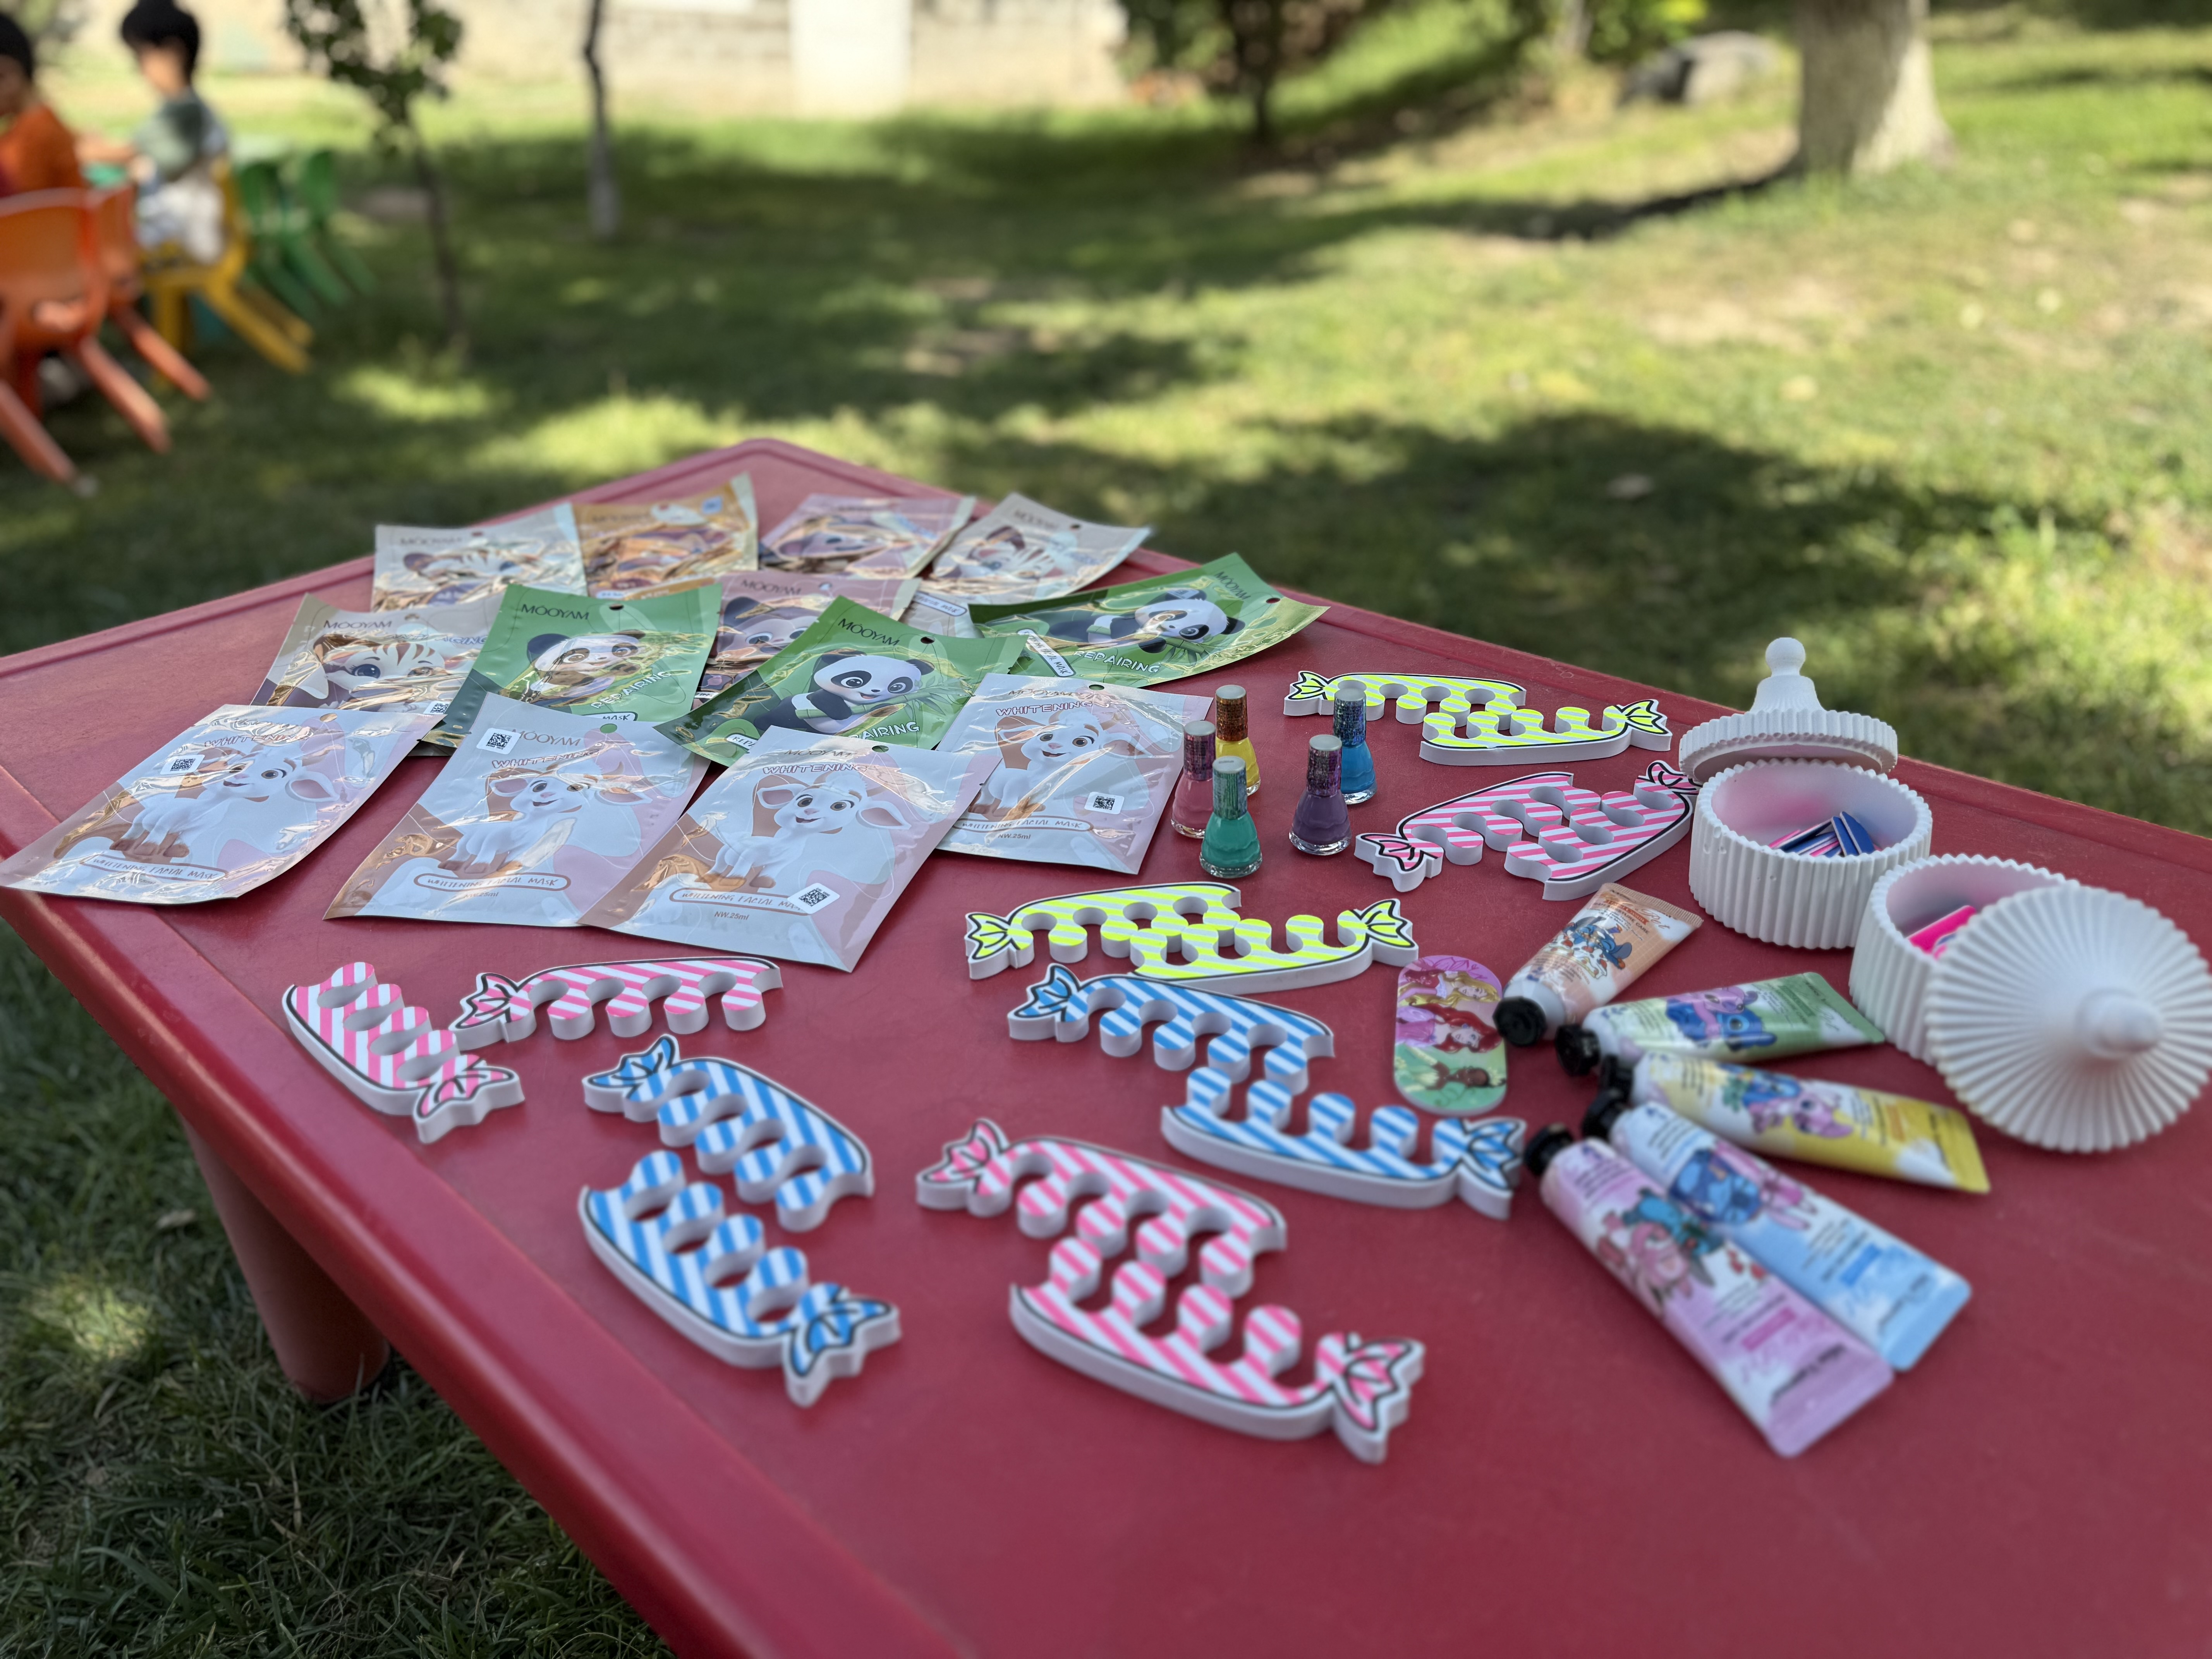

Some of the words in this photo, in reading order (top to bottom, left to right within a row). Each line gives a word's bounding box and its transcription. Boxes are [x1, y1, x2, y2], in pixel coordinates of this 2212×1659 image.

[1054, 661, 1071, 674] MASK
[1073, 651, 1161, 673] REPAIRING
[591, 670, 671, 709] REPAIRING
[996, 701, 1093, 716] WHITENING
[492, 749, 600, 769] WHITENING
[763, 763, 867, 774] WHITENING
[1055, 820, 1083, 828] MASK
[149, 867, 183, 876] FACIAL
[188, 871, 218, 879] MASK
[528, 878, 558, 886] MASK
[738, 895, 774, 905] FACIAL
[778, 900, 803, 911] MA
[714, 911, 750, 921] NW.25ml
